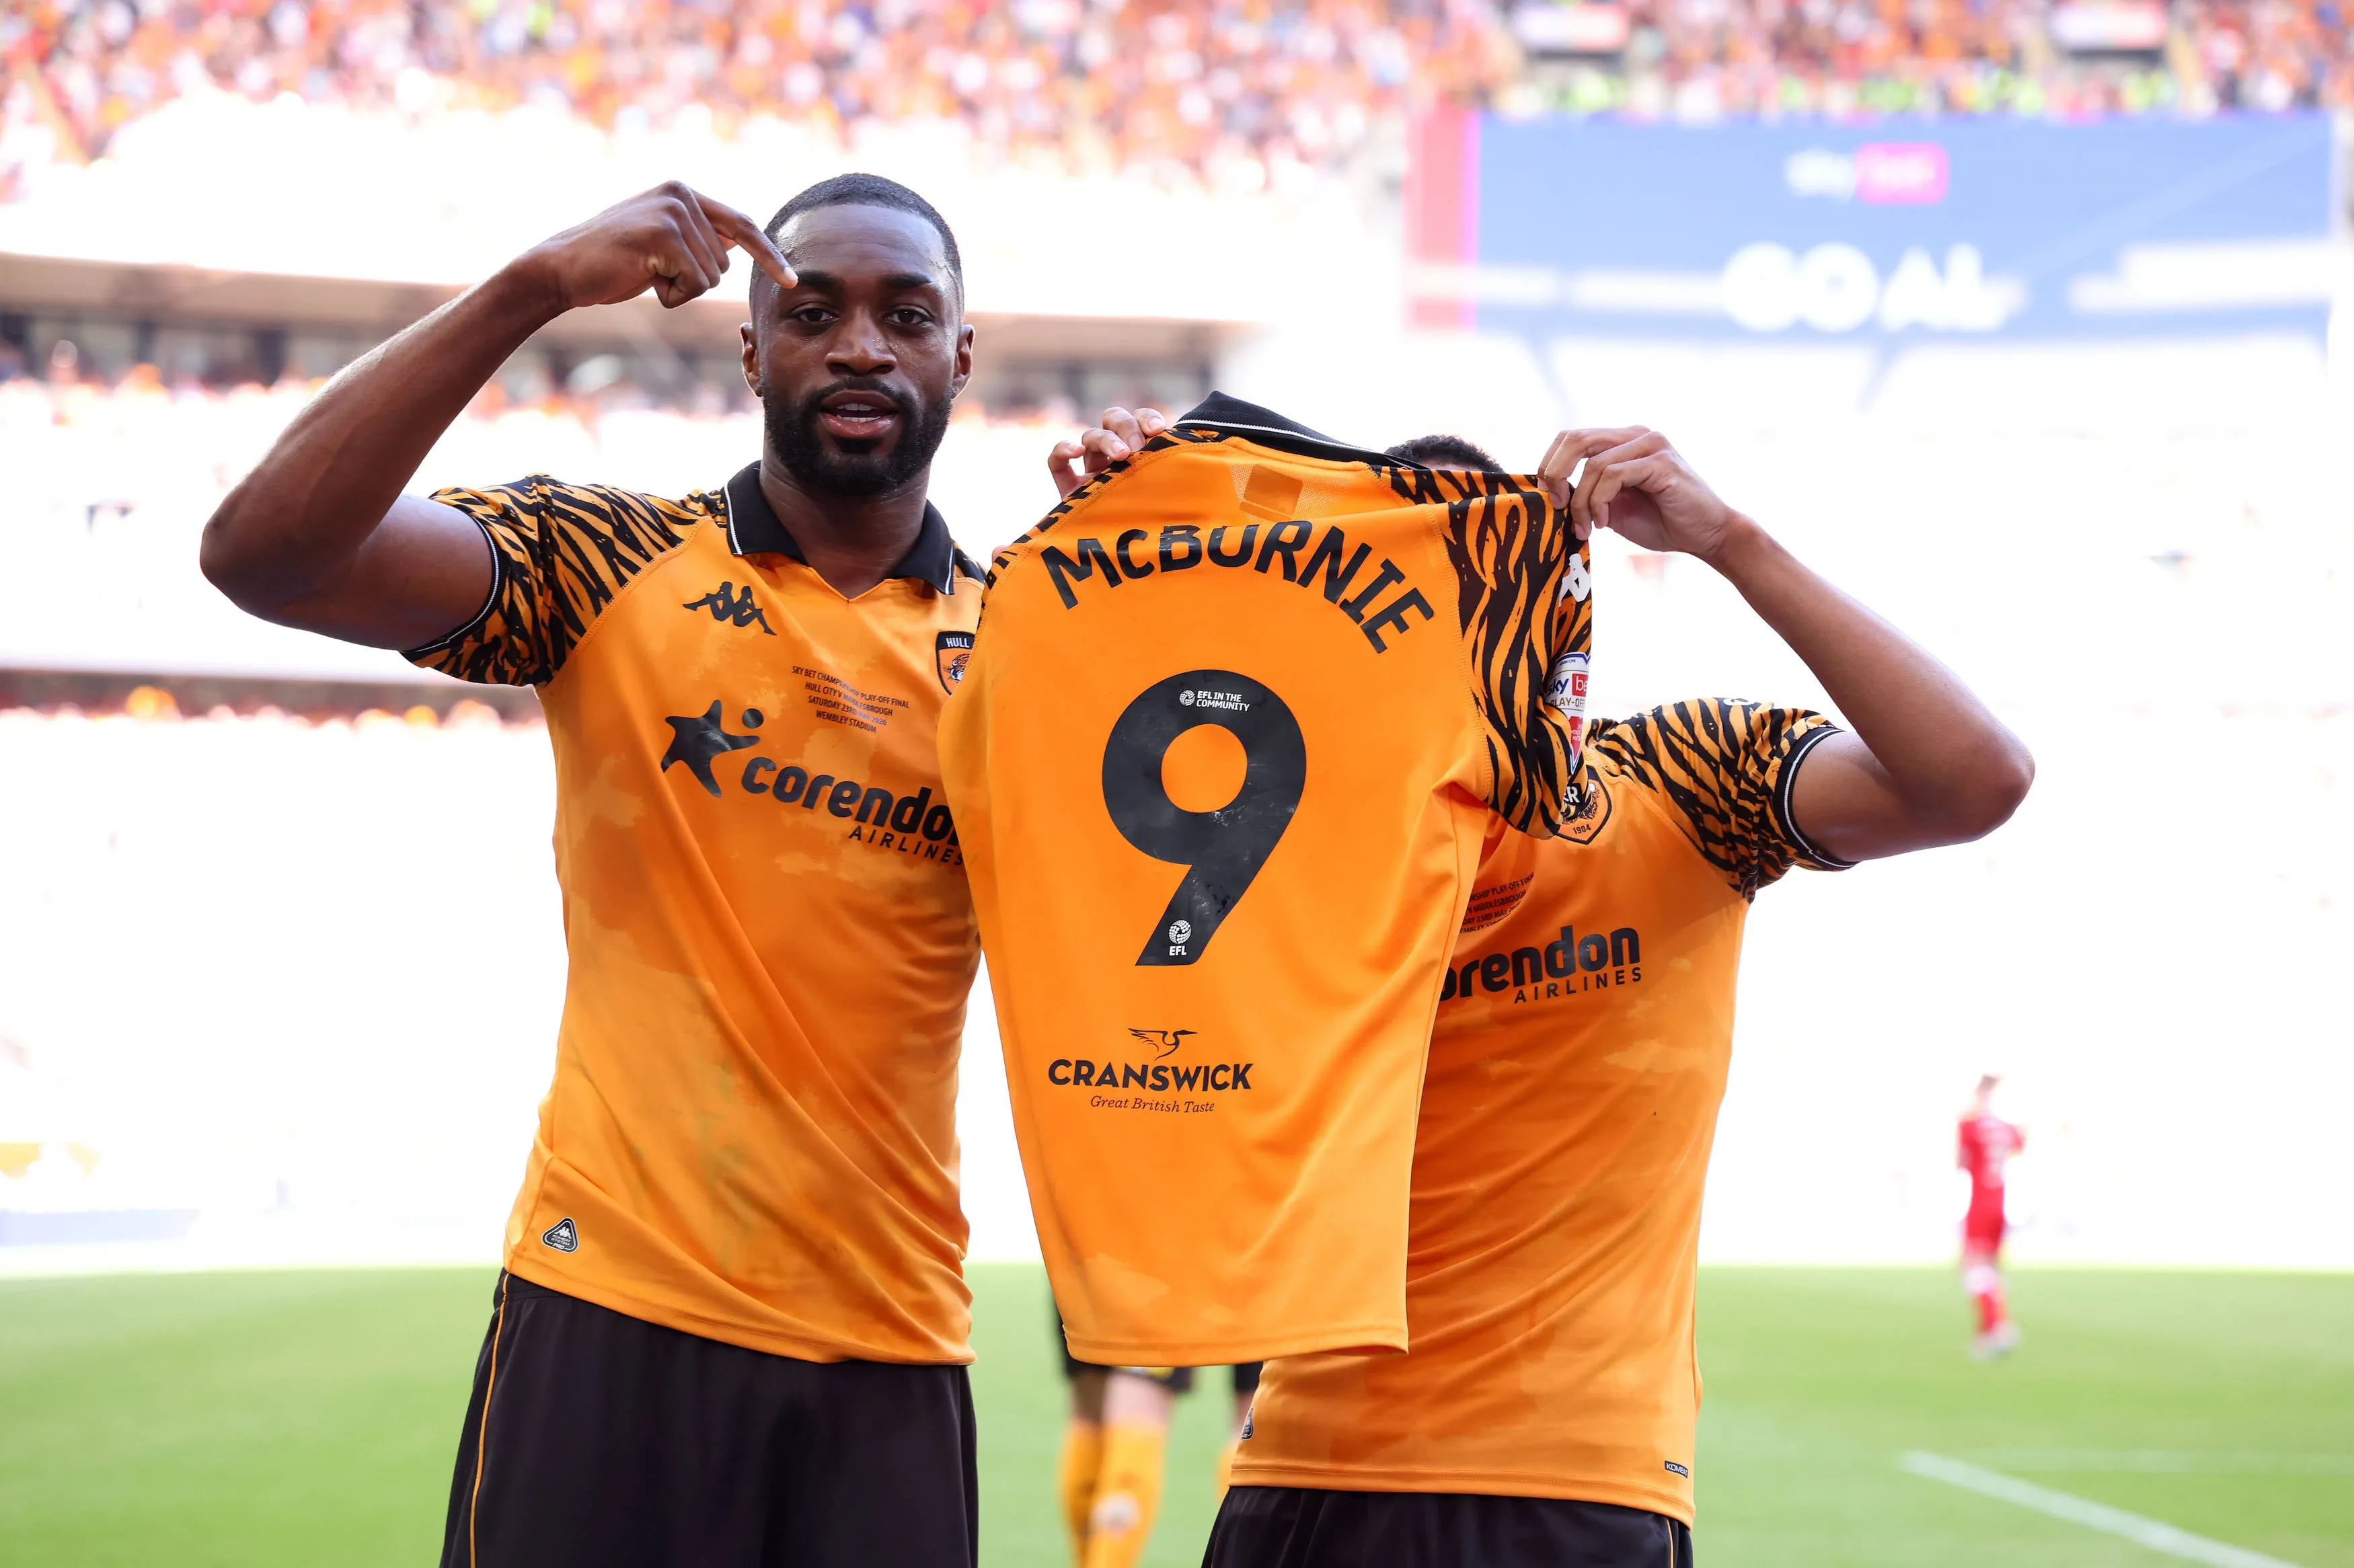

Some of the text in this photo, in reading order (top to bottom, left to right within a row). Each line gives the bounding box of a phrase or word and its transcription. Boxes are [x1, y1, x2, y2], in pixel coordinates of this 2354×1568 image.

[1723, 240, 2011, 332] GOAL
[1040, 520, 1435, 654] MCBURNIE
[946, 637, 970, 648] HULL
[792, 666, 909, 709] SKY BET CHAMPP PLAY-OFF FINAL
[805, 682, 821, 693] HULL
[823, 687, 838, 697] CITY
[1548, 675, 1587, 696] sky be
[808, 695, 841, 709] SATURDAY
[841, 704, 858, 715] 23RD
[1197, 691, 1242, 702] EFL IN THE
[1197, 699, 1250, 711] COMMUNITY
[816, 710, 877, 733] WEMBLEY STADIUM
[1102, 669, 1307, 966] 9
[1573, 824, 1591, 834] 1904
[848, 826, 963, 865] AIRLINES
[1491, 881, 1520, 895] PLAY-OFF
[1521, 871, 1534, 886] FINA
[1459, 924, 1484, 934] EMBLEY
[1462, 917, 1475, 925] DAY
[1169, 945, 1187, 955] EFL
[1439, 925, 1640, 1002] orendon
[1514, 967, 1642, 1004] AIRLINES
[1048, 1059, 1254, 1093] CRANSWICK
[1090, 1095, 1215, 1113] Great British Taste
